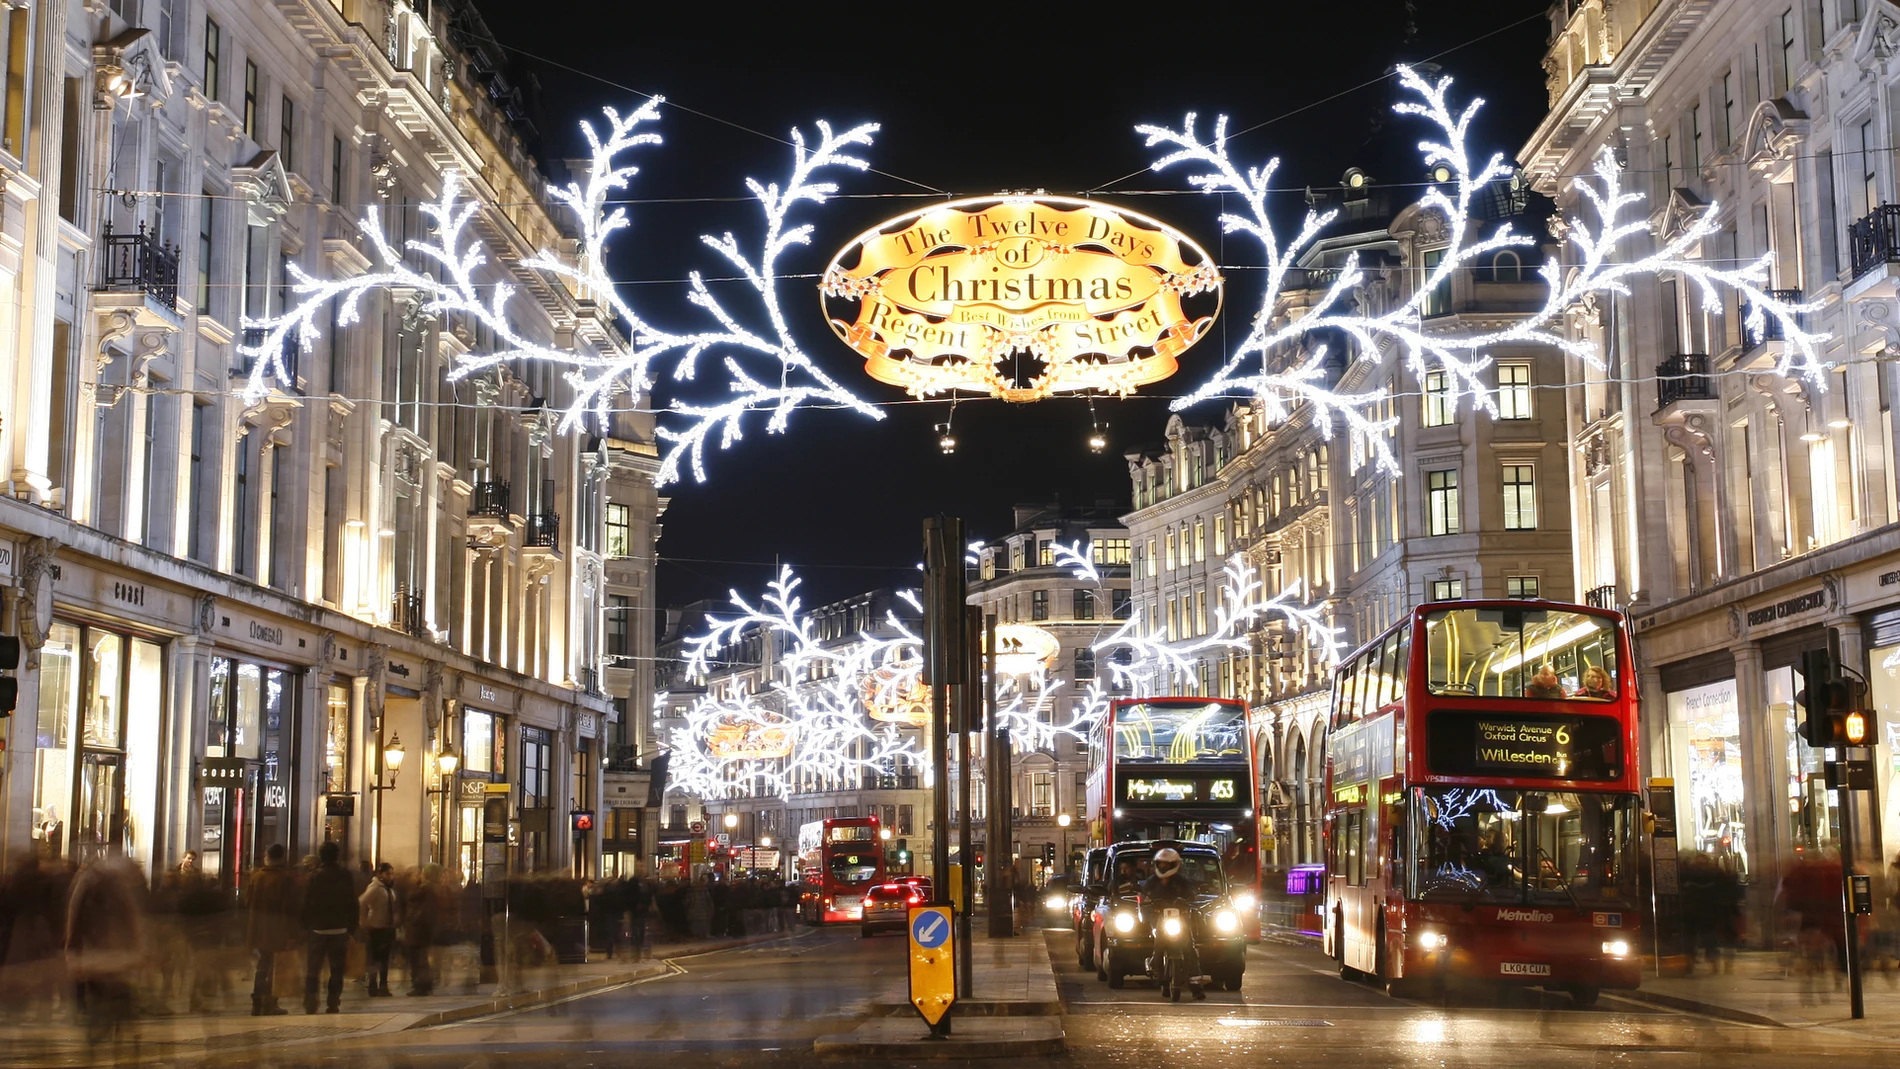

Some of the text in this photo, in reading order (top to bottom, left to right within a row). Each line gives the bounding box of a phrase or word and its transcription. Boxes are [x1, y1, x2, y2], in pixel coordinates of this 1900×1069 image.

[894, 211, 1155, 260] The Twelve Days
[1004, 240, 1033, 264] of
[907, 264, 1133, 303] Christmas
[866, 300, 1165, 350] Regent Street
[960, 306, 1081, 331] Best Wishes from
[114, 581, 145, 607] coast
[1747, 604, 1777, 627] FRENCH
[1685, 689, 1731, 711] French Connection
[1478, 722, 1570, 745] Warwick Avenue 6
[1484, 732, 1547, 743] Oxford Circus
[1481, 748, 1551, 764] Willesden
[202, 767, 244, 778] coast
[1210, 780, 1234, 799] 453
[848, 855, 859, 864] 453
[1496, 908, 1554, 923] Metroline
[1503, 963, 1547, 974] LK04 CUA
